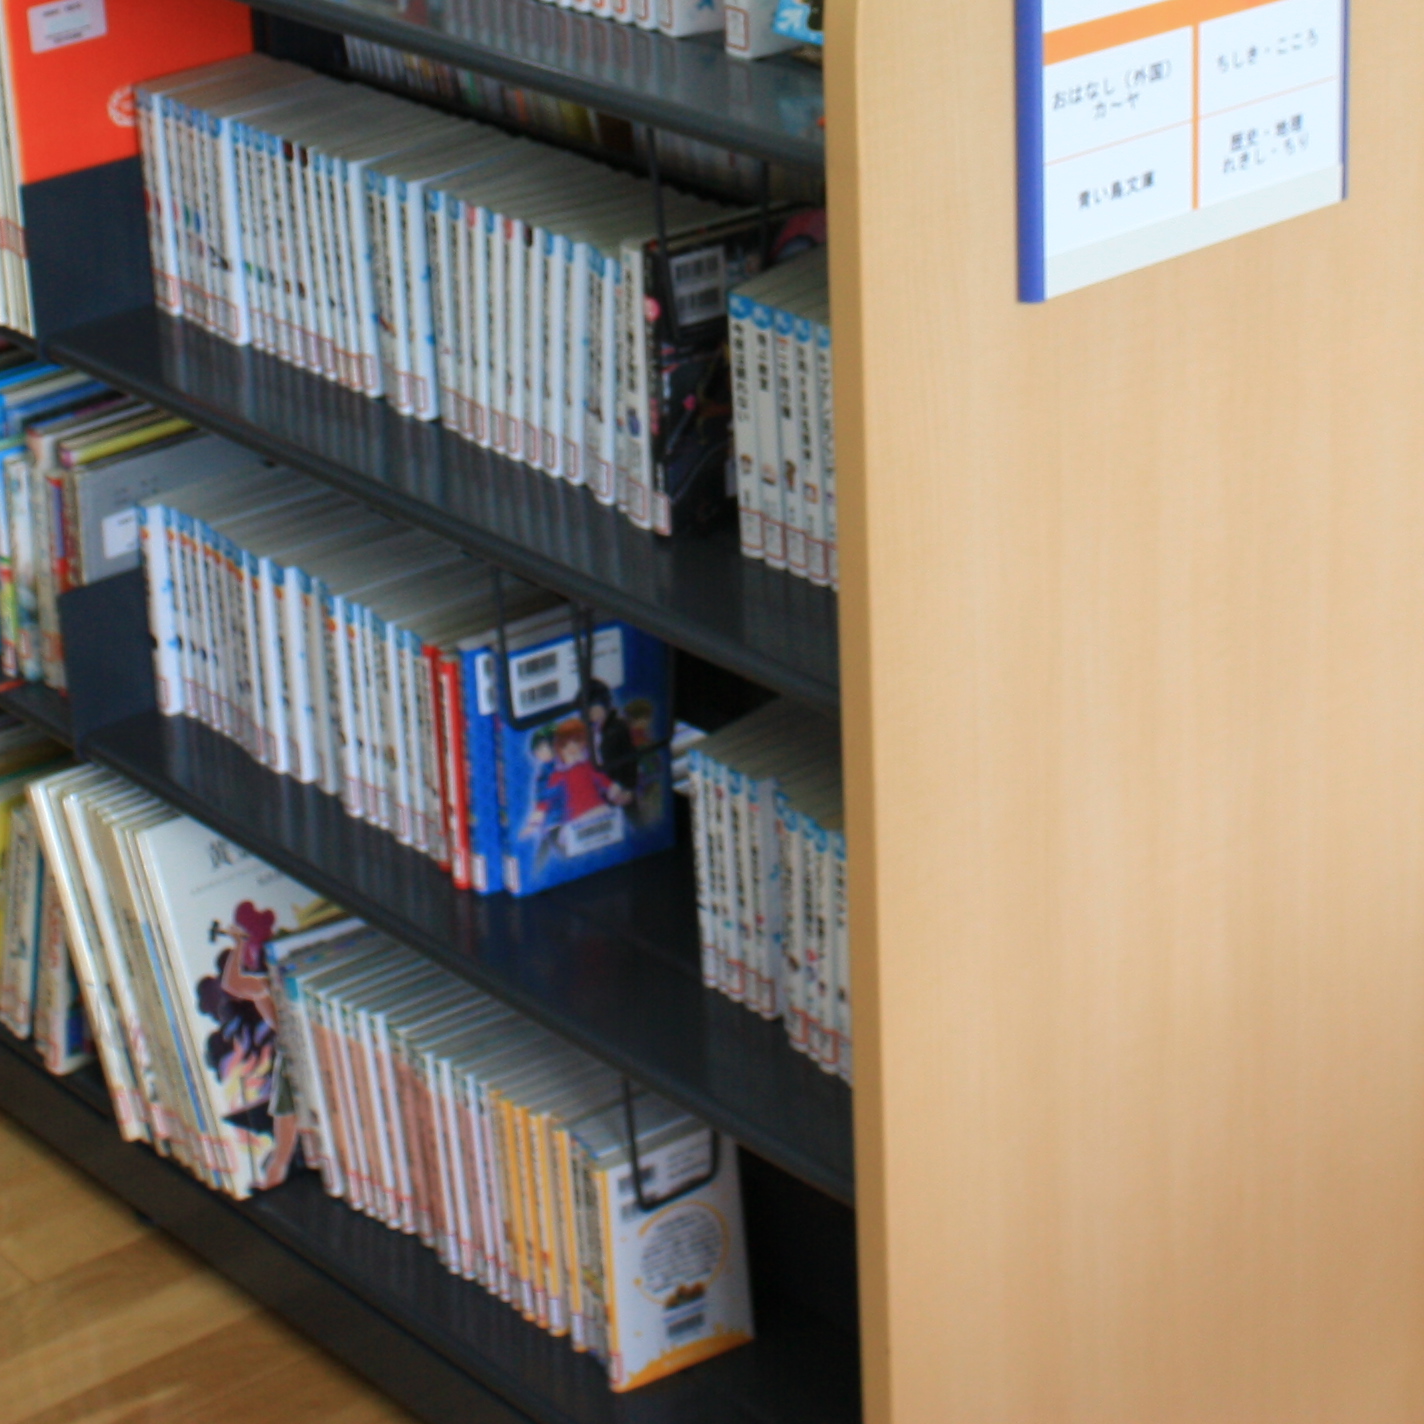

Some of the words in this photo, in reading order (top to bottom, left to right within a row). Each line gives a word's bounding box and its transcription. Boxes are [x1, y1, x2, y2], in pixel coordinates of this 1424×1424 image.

[1217, 29, 1318, 72] ちしき・こころ
[1078, 169, 1156, 211] 青い鳥文庫
